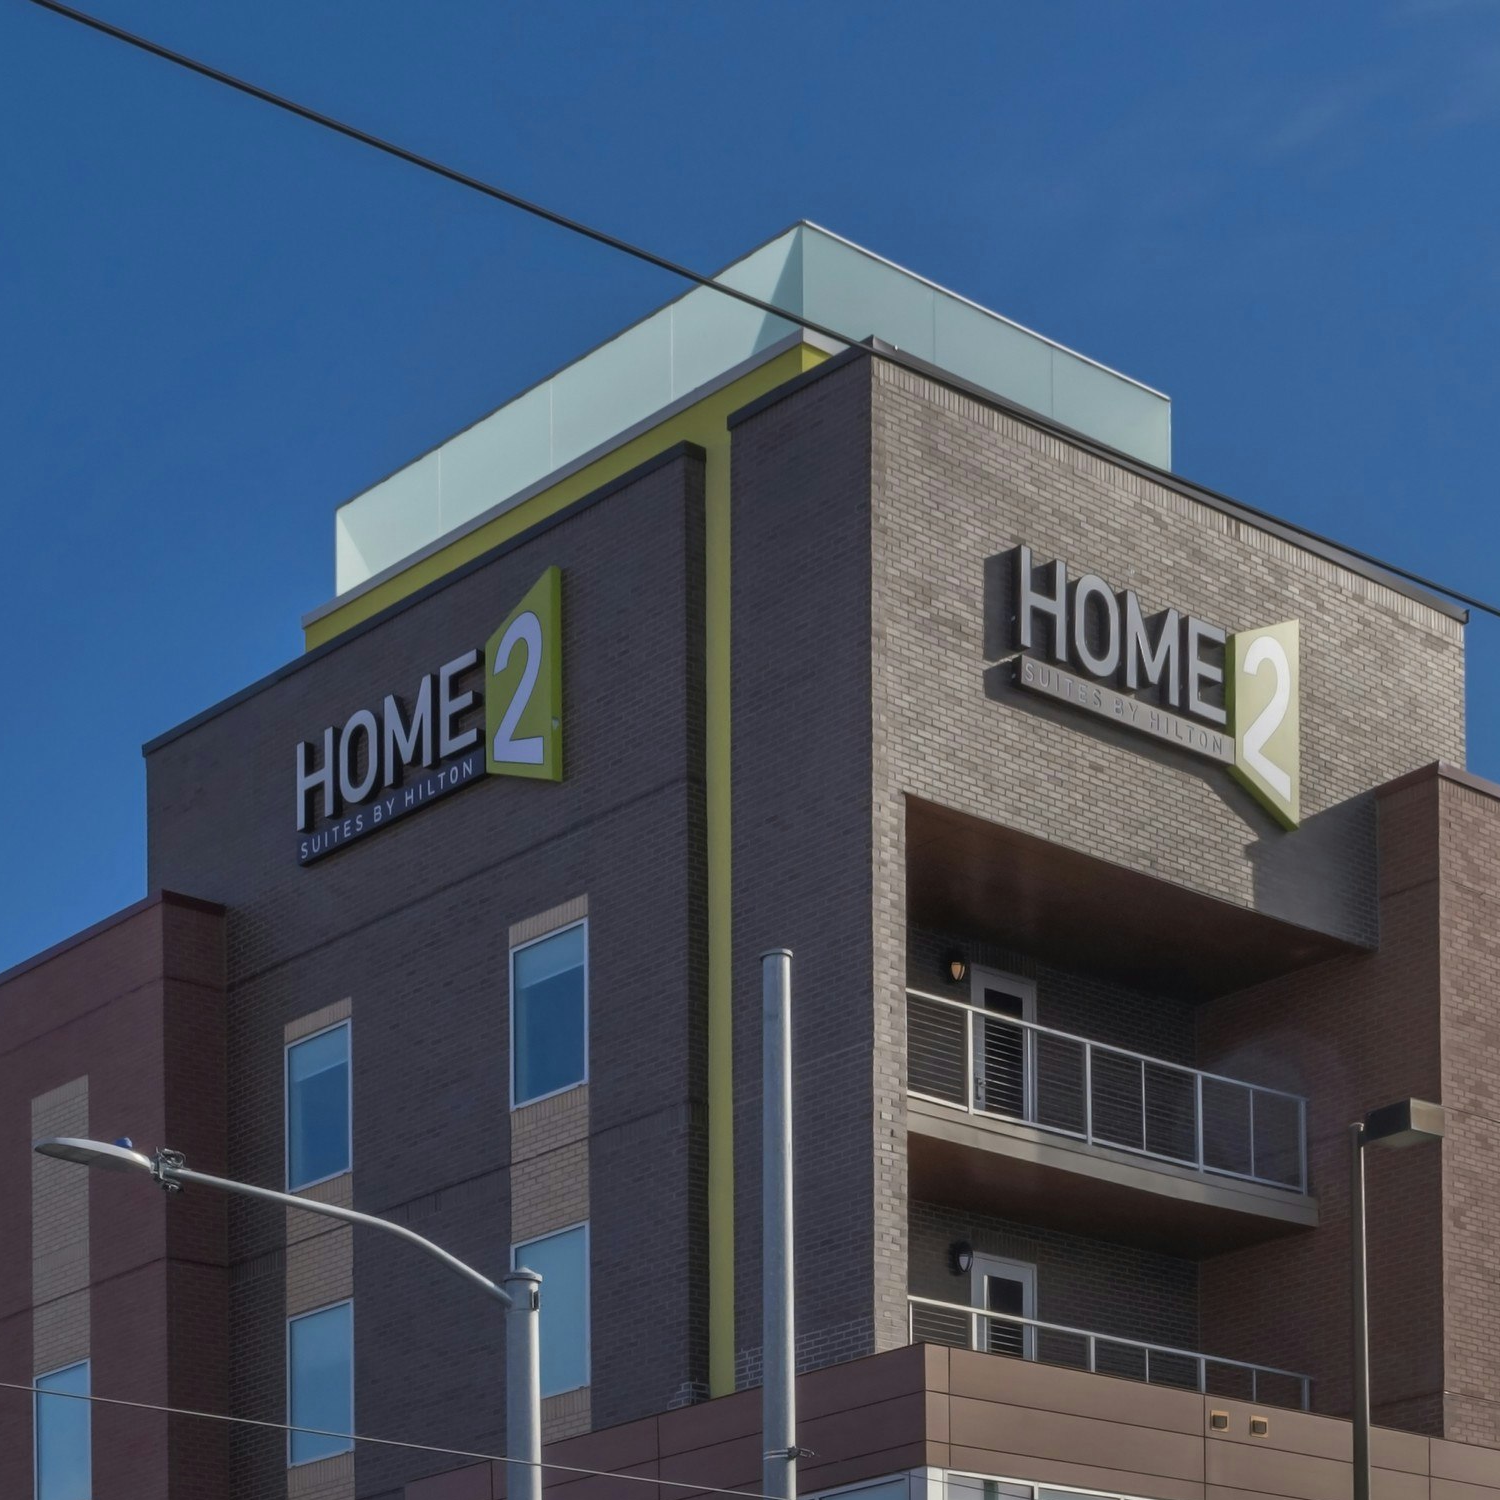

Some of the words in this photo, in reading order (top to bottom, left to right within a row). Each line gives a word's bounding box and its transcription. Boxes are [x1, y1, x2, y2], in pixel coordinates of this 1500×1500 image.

[296, 648, 479, 832] HOME
[493, 610, 544, 765] 2
[1020, 544, 1227, 725] HOME
[1243, 635, 1293, 803] 2
[1024, 662, 1102, 709] SUITES
[1114, 698, 1140, 724] BY
[1149, 711, 1224, 756] HILTON
[300, 813, 364, 861] SUITES
[372, 797, 396, 824] BY
[404, 757, 474, 808] HILTON
